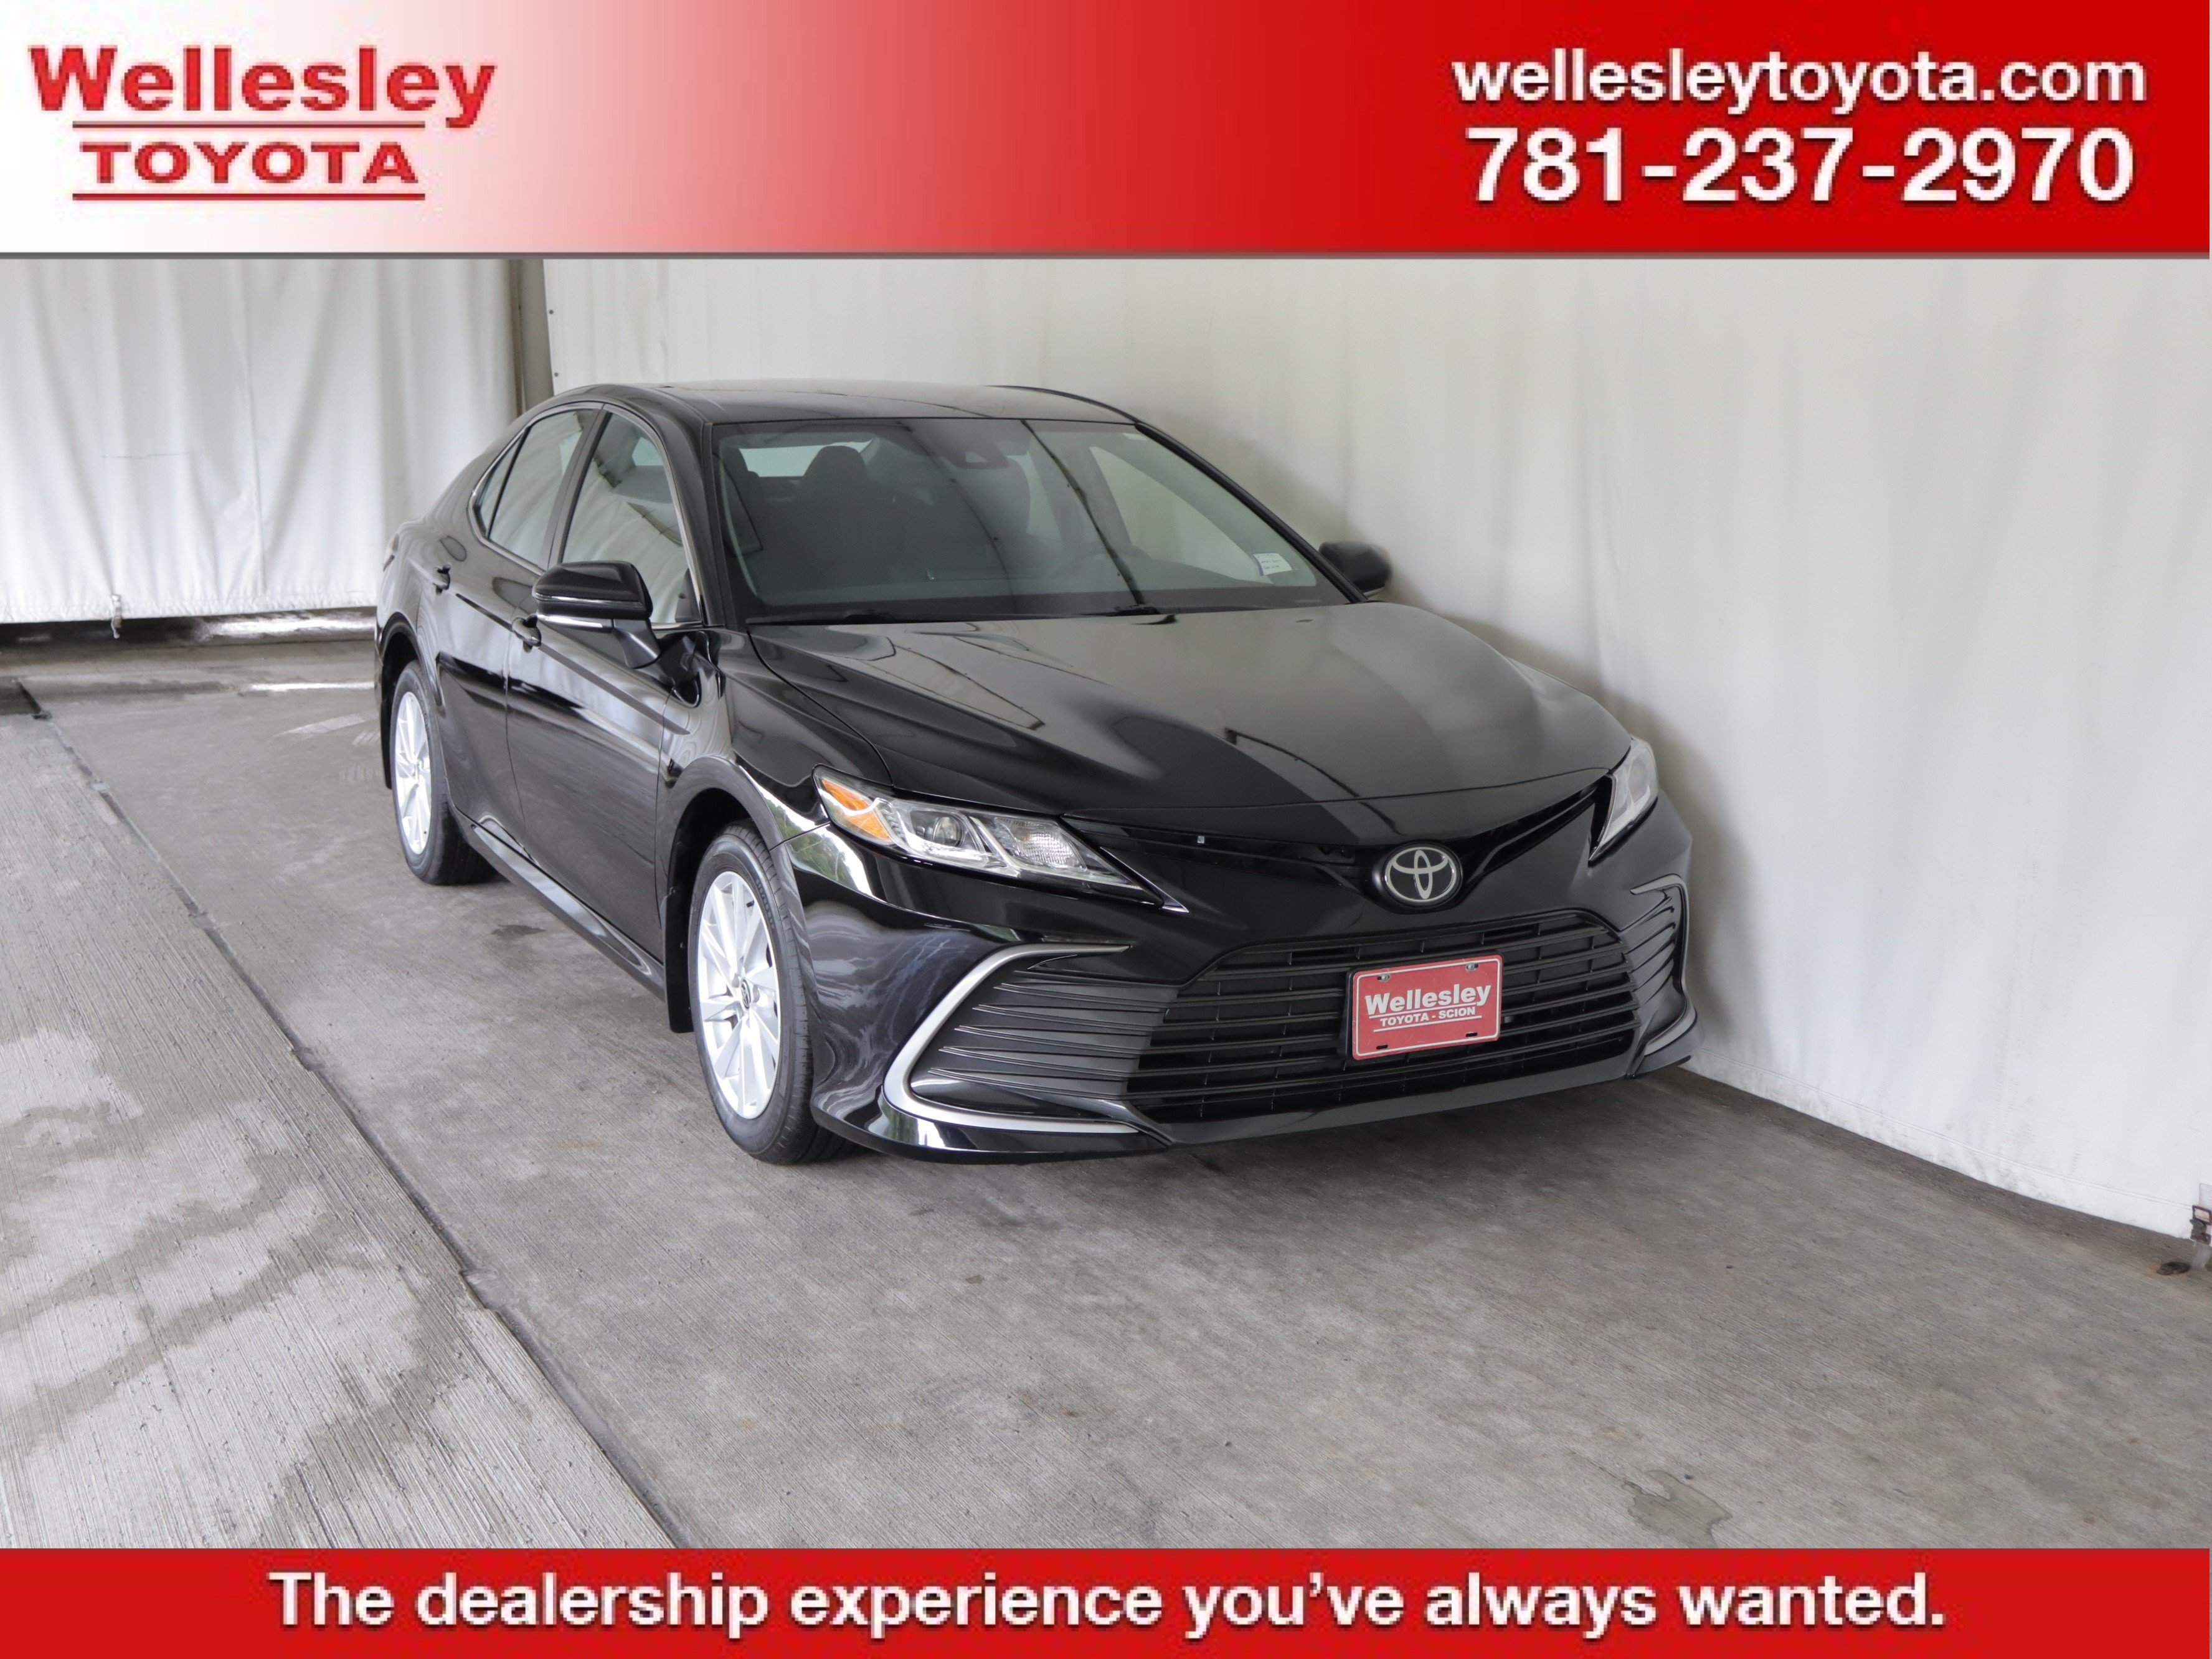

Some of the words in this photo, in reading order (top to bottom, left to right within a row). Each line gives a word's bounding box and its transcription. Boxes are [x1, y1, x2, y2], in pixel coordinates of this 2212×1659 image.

[1364, 983, 1492, 1016] Wellesley
[1379, 1013, 1430, 1027] TOYOTA
[1438, 1006, 1477, 1020] SCION
